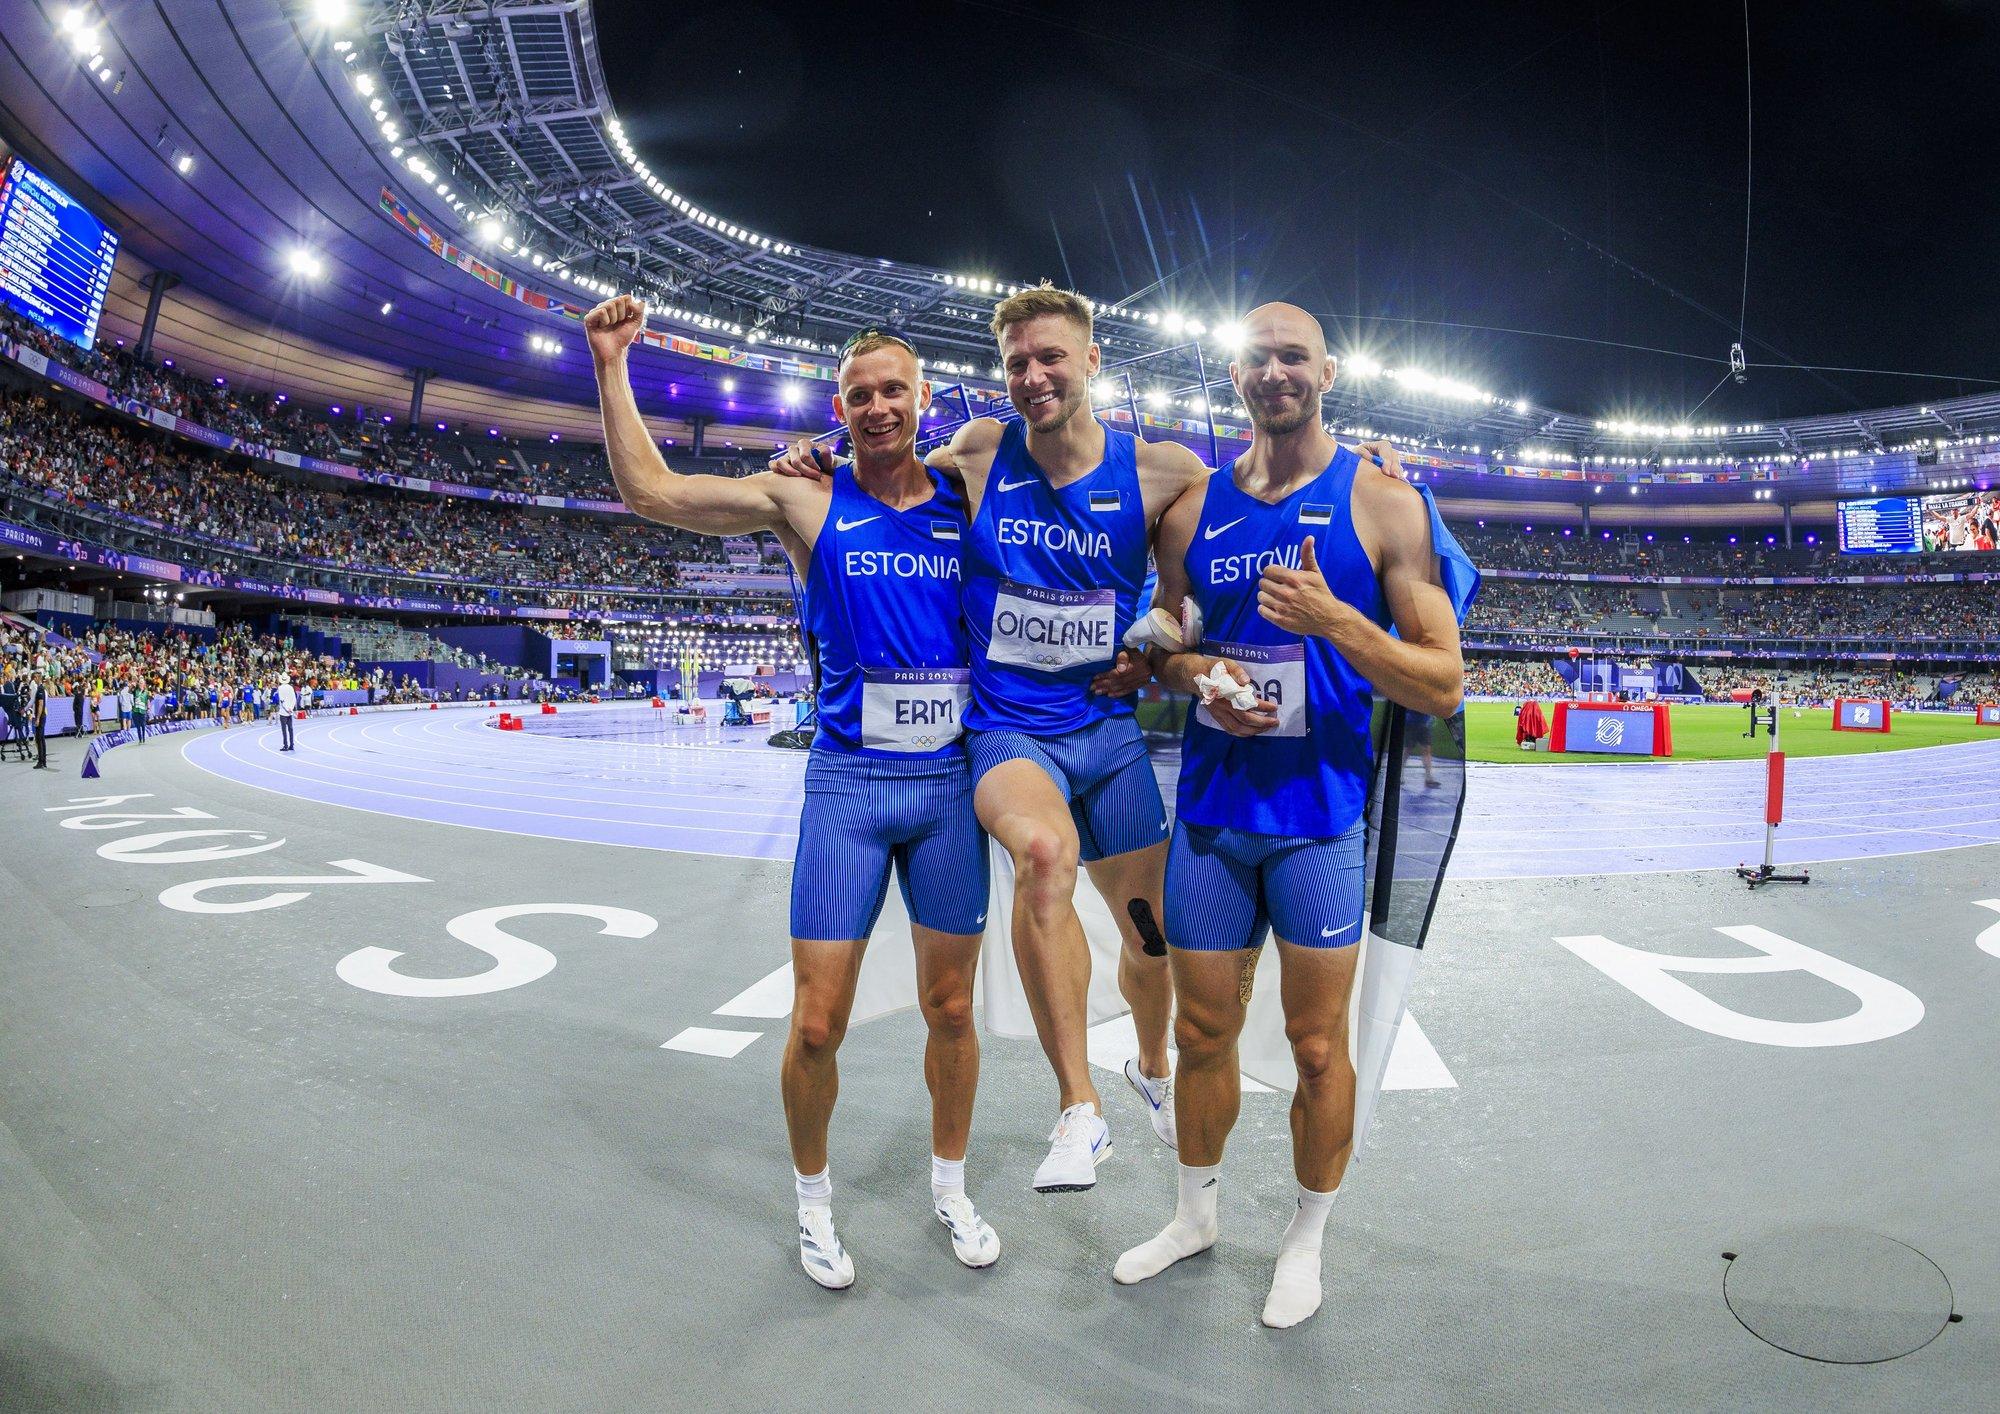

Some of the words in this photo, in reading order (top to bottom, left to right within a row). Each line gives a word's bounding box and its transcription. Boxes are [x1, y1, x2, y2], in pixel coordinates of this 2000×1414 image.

[25, 534, 43, 547] 2024
[998, 518, 1112, 558] ESTONIA
[845, 551, 961, 582] ESTONIA
[1211, 544, 1303, 585] ESTONI
[1060, 594, 1086, 602] 2024
[1245, 649, 1269, 659] 2024
[928, 672, 954, 681] 2024
[895, 699, 954, 725] ERM
